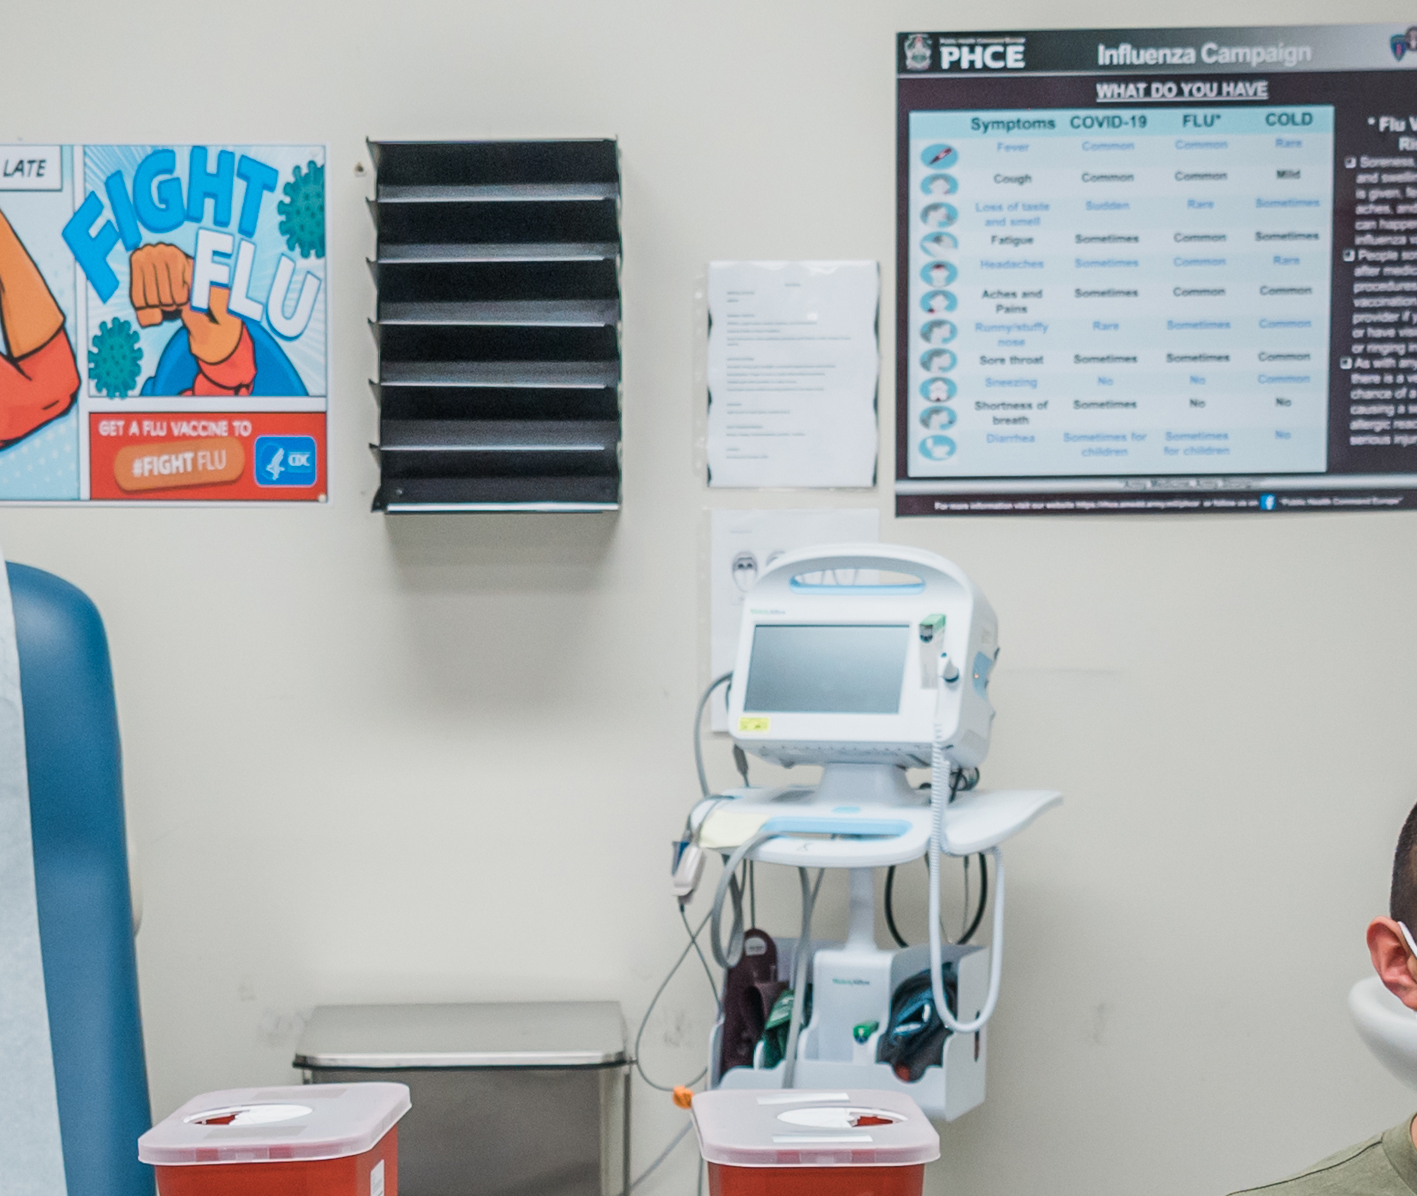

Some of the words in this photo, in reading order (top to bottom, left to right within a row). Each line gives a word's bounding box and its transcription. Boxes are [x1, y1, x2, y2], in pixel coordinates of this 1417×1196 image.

[940, 45, 1026, 69] PHCE
[1098, 43, 1196, 65] Influenza
[1201, 42, 1312, 67] Campaign
[1096, 83, 1147, 99] WHAT
[1151, 82, 1177, 97] DO
[1181, 81, 1218, 97] YOU
[1221, 80, 1268, 97] HAVE
[1070, 115, 1148, 129] COVID-19
[1265, 112, 1313, 126] COLD
[1379, 116, 1406, 132] Flu
[971, 117, 1056, 133] Symptoms
[997, 142, 1029, 152] Fever
[1082, 141, 1134, 151] Common
[1175, 140, 1228, 150] Common
[1275, 139, 1303, 148] Rare
[3, 159, 47, 177] LATE
[994, 174, 1032, 185] Cough
[1082, 173, 1134, 182] Common
[1175, 172, 1227, 181] Common
[1022, 203, 1050, 211] taste
[1086, 201, 1130, 211] Sudden
[1187, 199, 1214, 209] Rare
[1255, 198, 1320, 208] Sometimes
[62, 146, 279, 304] FIGHT
[1010, 217, 1041, 226] smell
[1075, 234, 1139, 244] Sometimes
[1173, 233, 1227, 242] Common
[1255, 231, 1319, 241] Sometimes
[991, 235, 1034, 248] Fatigue
[1075, 258, 1139, 268] Sometimes
[1173, 257, 1226, 266] Common
[1273, 256, 1300, 265] Rare
[191, 227, 321, 342] FLU
[982, 290, 1017, 299] Aches
[1075, 288, 1139, 298] Sometimes
[1173, 287, 1226, 296] Common
[1259, 286, 1312, 295] Common
[996, 304, 1027, 314] Pains
[1092, 321, 1119, 331] Rare
[1167, 320, 1231, 330] Sometimes
[1259, 319, 1311, 329] Common
[980, 356, 1006, 365] Sore
[1010, 356, 1044, 365] throat
[1074, 354, 1138, 364] Sometimes
[1166, 353, 1230, 363] Sometimes
[1258, 352, 1311, 361] Common
[985, 378, 1038, 389] Sneezing
[1097, 376, 1114, 386] No
[1190, 375, 1206, 385] No
[1258, 374, 1310, 383] Common
[975, 401, 1033, 411] Shortness
[1073, 400, 1137, 409] Sometimes
[1190, 399, 1206, 408] No
[1275, 398, 1292, 407] No
[992, 416, 1029, 425] breath
[99, 420, 126, 436] GET
[129, 420, 140, 436] A
[142, 420, 167, 436] FLU
[171, 420, 229, 437] VACCINE
[232, 420, 252, 436] TO
[987, 434, 1035, 443] Diarrhea
[1063, 432, 1127, 442] Sometimes
[1165, 431, 1229, 441] Sometimes
[1275, 430, 1291, 439] No
[132, 451, 195, 477] #FIGHT
[197, 450, 227, 470] FLU
